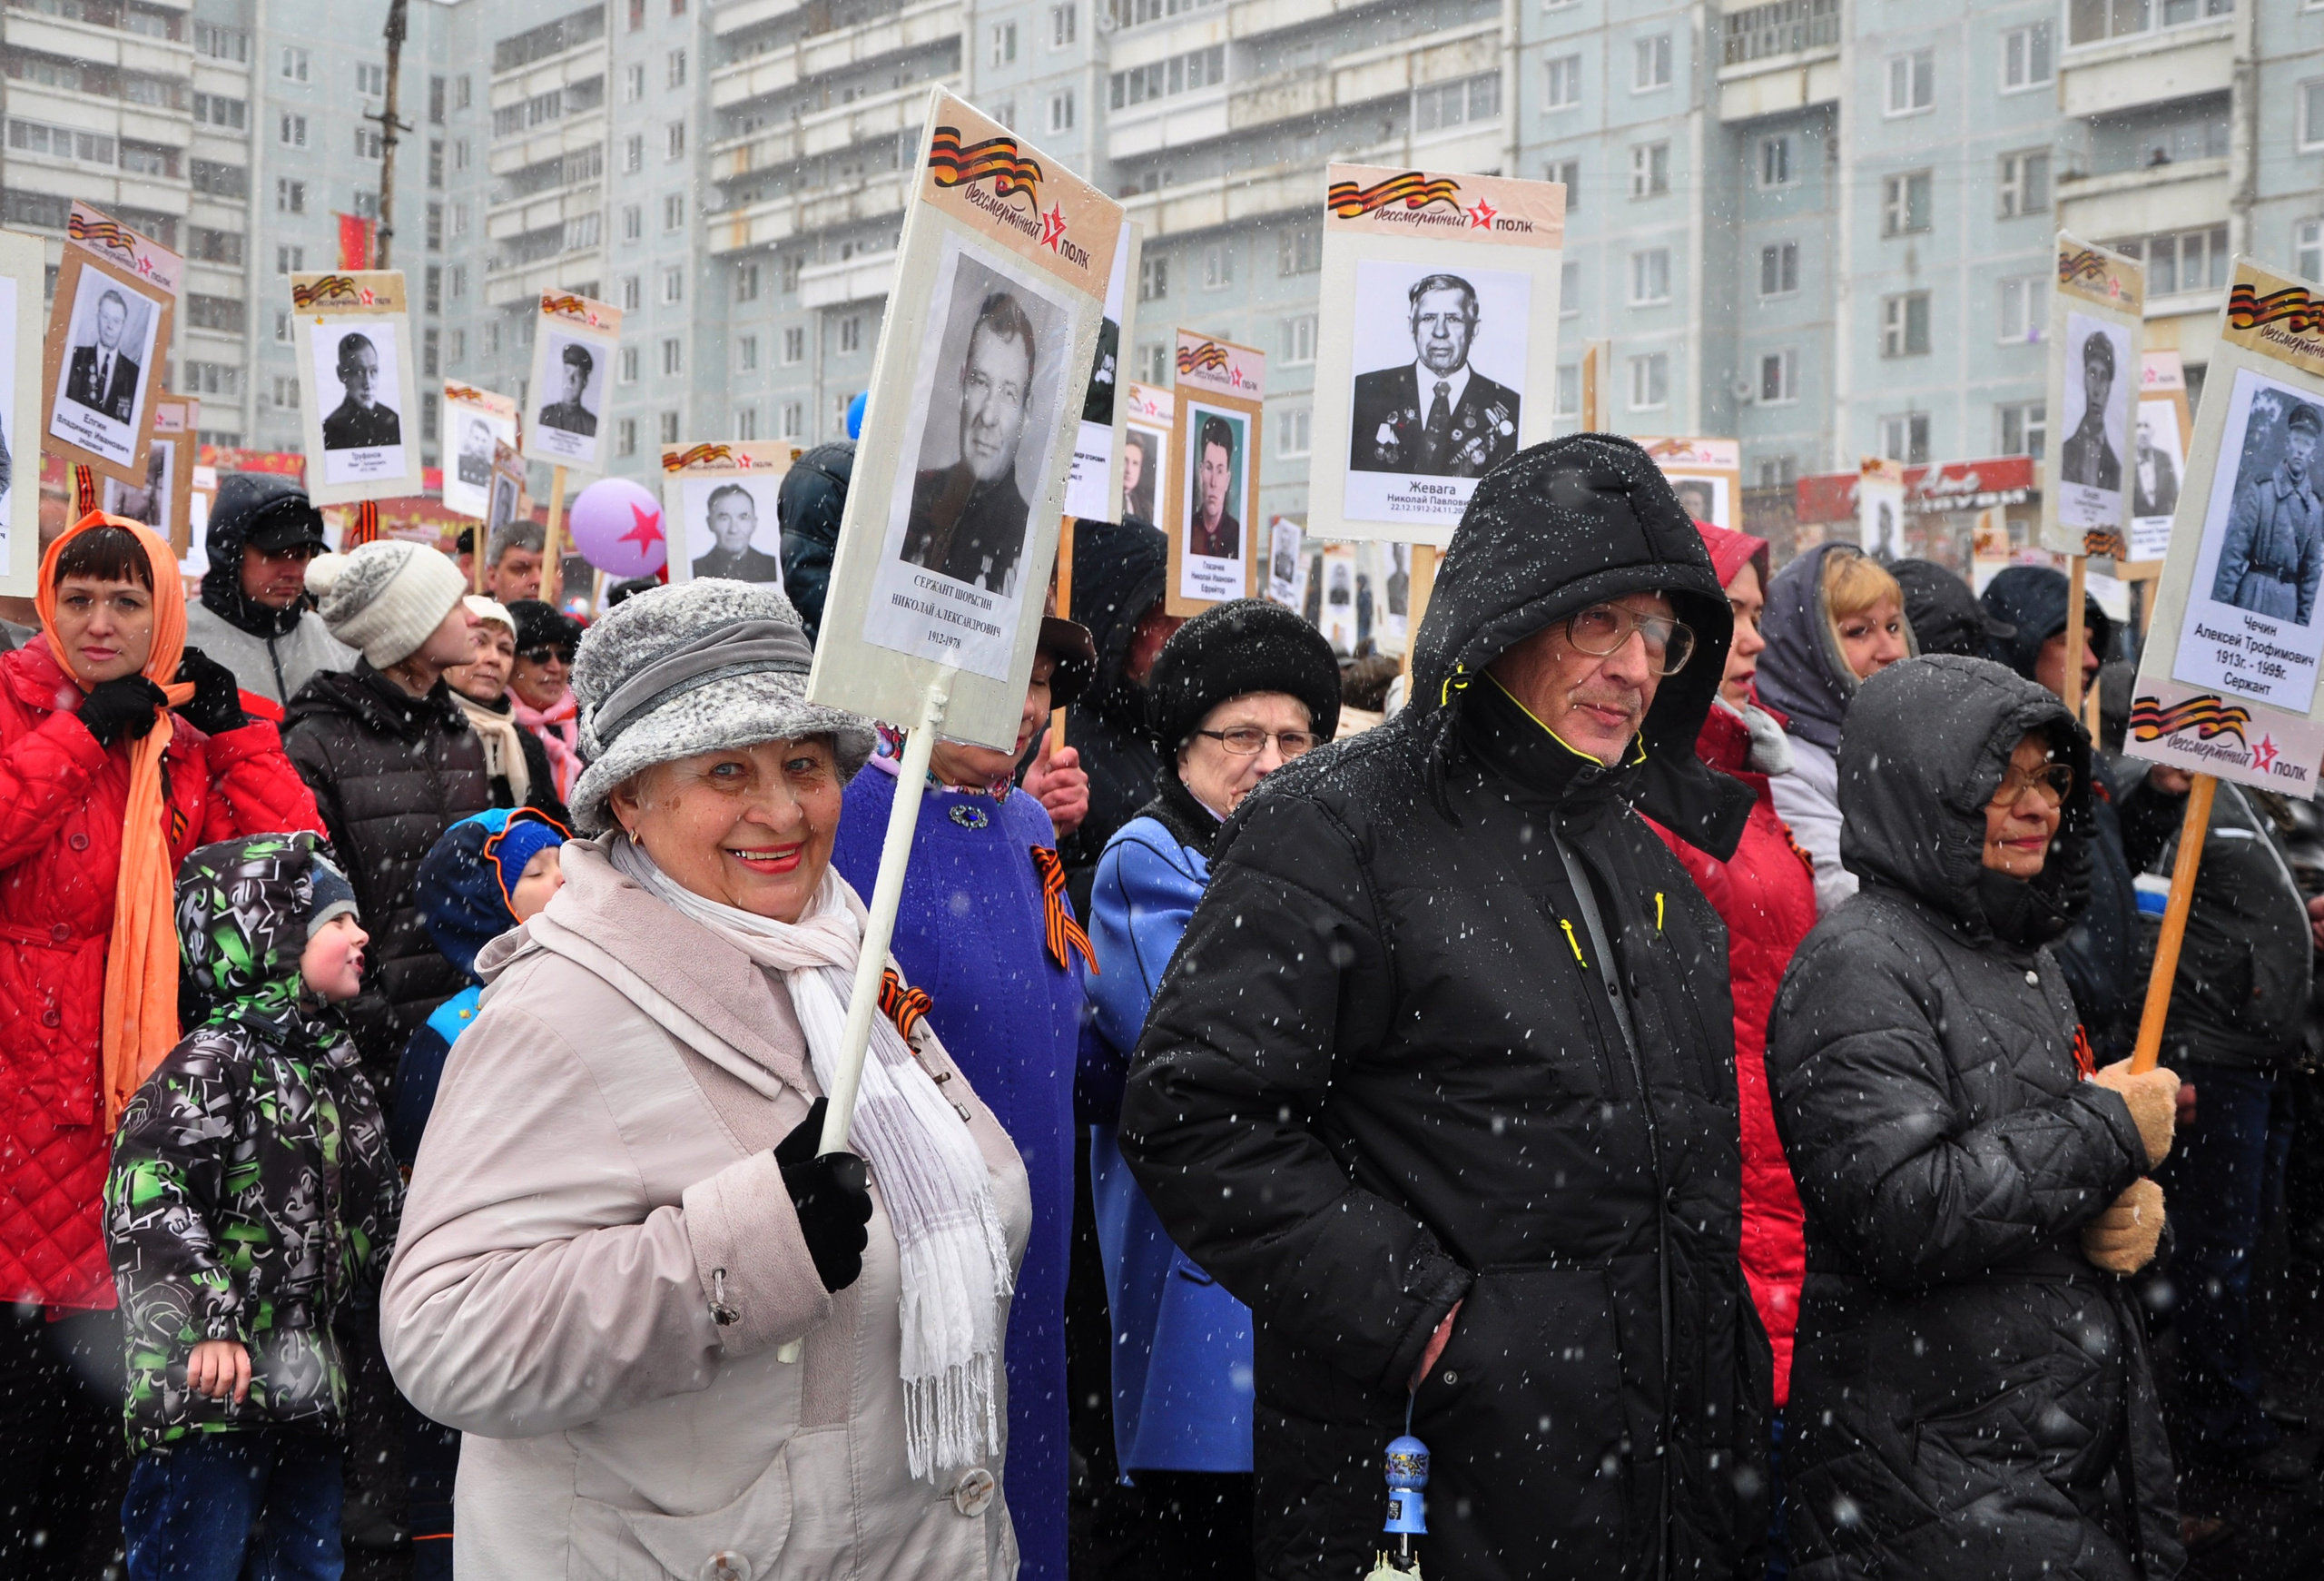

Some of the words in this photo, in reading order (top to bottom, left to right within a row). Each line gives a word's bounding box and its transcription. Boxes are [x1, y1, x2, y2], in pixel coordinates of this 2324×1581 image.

[964, 181, 1042, 240] бессмертный
[1374, 206, 1469, 227] бессмертный
[84, 413, 106, 431] Елгин
[56, 413, 93, 437] Владимир
[94, 431, 129, 453] Иванович
[1409, 481, 1456, 495] Жевага
[1387, 493, 1428, 503] Николай
[1430, 496, 1470, 506] Павлови
[913, 574, 955, 598] СЕРЖАНТ
[1191, 571, 1211, 581] Николай
[1213, 573, 1236, 583] Иванович
[1201, 583, 1226, 596] Ефрейтор
[891, 593, 935, 617] НИКОЛАЙ
[934, 609, 1001, 637] АЛЕКСАНДРОВИЧ
[2244, 615, 2278, 637] Чечин
[927, 629, 962, 649] 1912-1978
[2194, 622, 2242, 647] Алексей
[2245, 636, 2315, 667] Трофимович
[2216, 648, 2247, 669] 1913г.
[2223, 671, 2271, 696] Сержант
[2167, 733, 2252, 767] бессмертный
